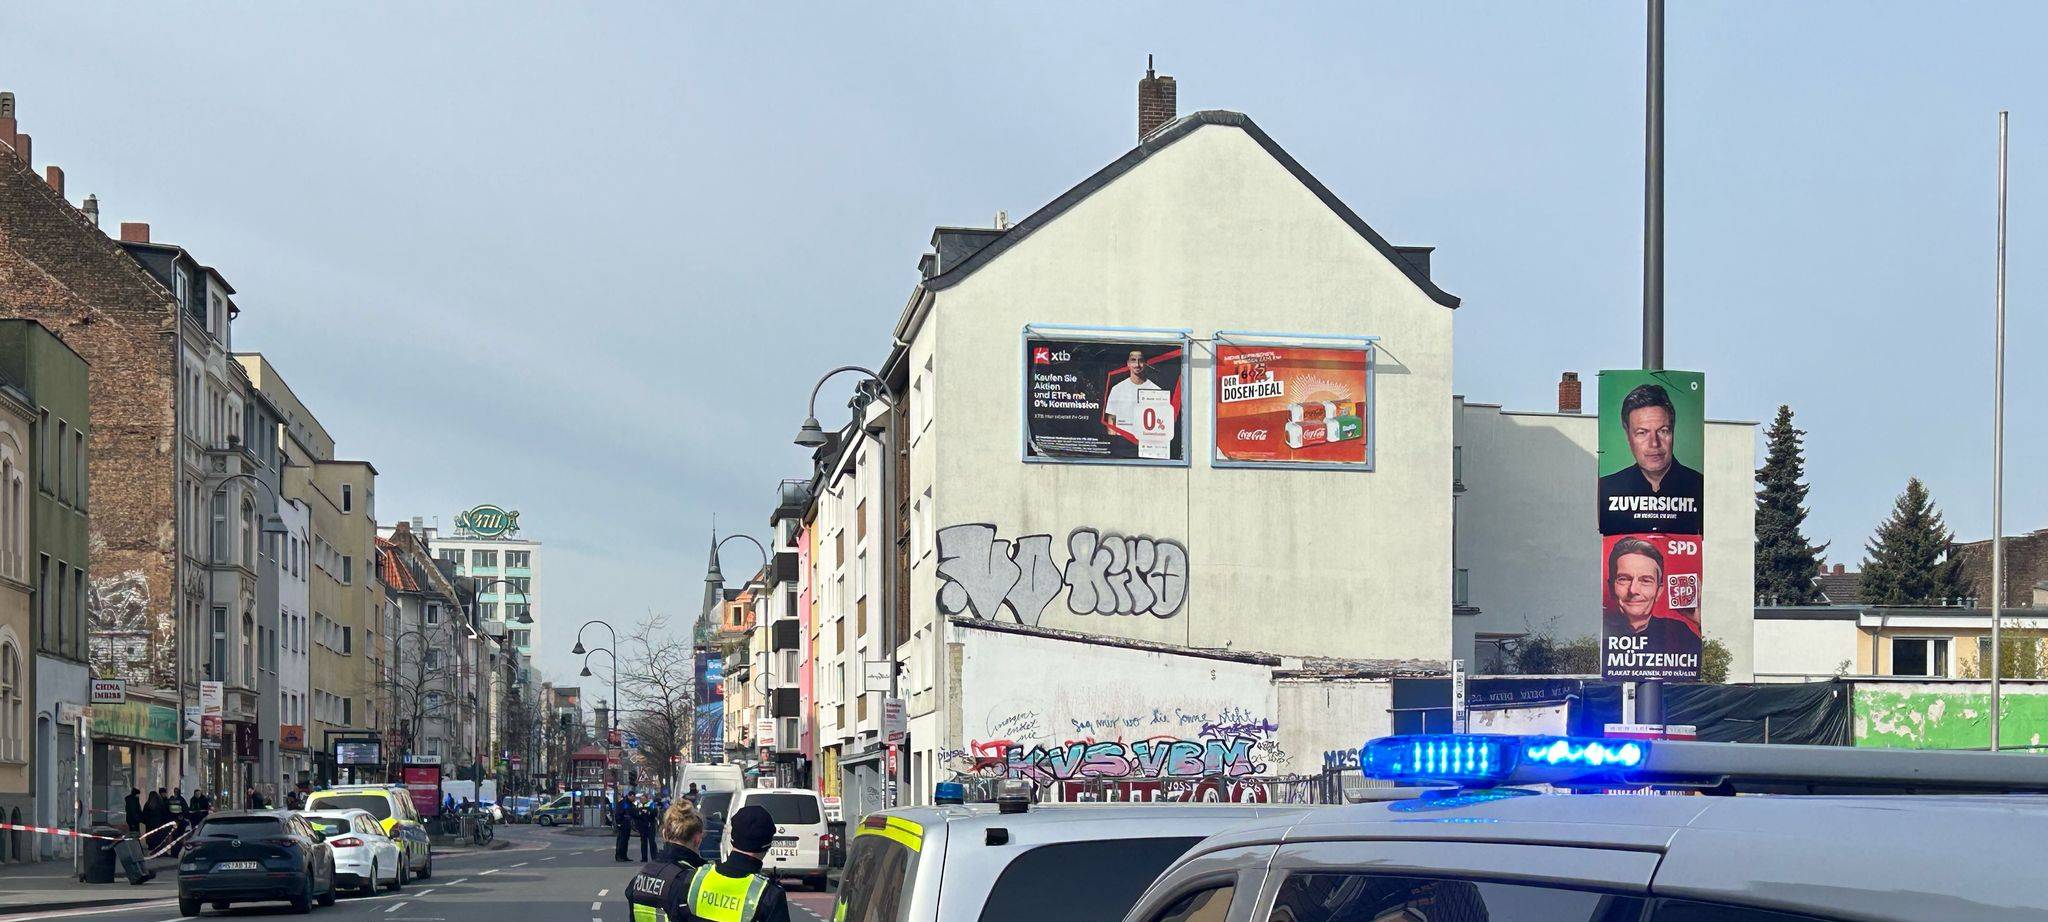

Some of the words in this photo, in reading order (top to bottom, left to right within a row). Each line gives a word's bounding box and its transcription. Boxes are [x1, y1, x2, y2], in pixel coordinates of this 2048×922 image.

[1051, 349, 1071, 361] xtb
[1034, 373, 1063, 382] Kaufen
[1064, 374, 1077, 382] Sie
[1223, 377, 1237, 387] DER
[1034, 382, 1060, 391] Aktien
[1224, 382, 1282, 401] DOSEN-DEAL
[1034, 391, 1049, 399] und
[1051, 391, 1072, 400] ETFs
[1034, 400, 1047, 408] 0%
[1049, 400, 1100, 410] Kommission
[1608, 496, 1697, 512] ZUVERSICHT.
[1668, 541, 1698, 556] SPD
[1673, 586, 1693, 597] SPD
[1608, 636, 1648, 650] ROLF
[1607, 650, 1698, 667] MÜTZENICH
[95, 683, 120, 691] CHINA
[771, 848, 798, 856] OLIZEI
[633, 874, 665, 896] POLIZEI
[701, 890, 741, 912] POLIZEI
